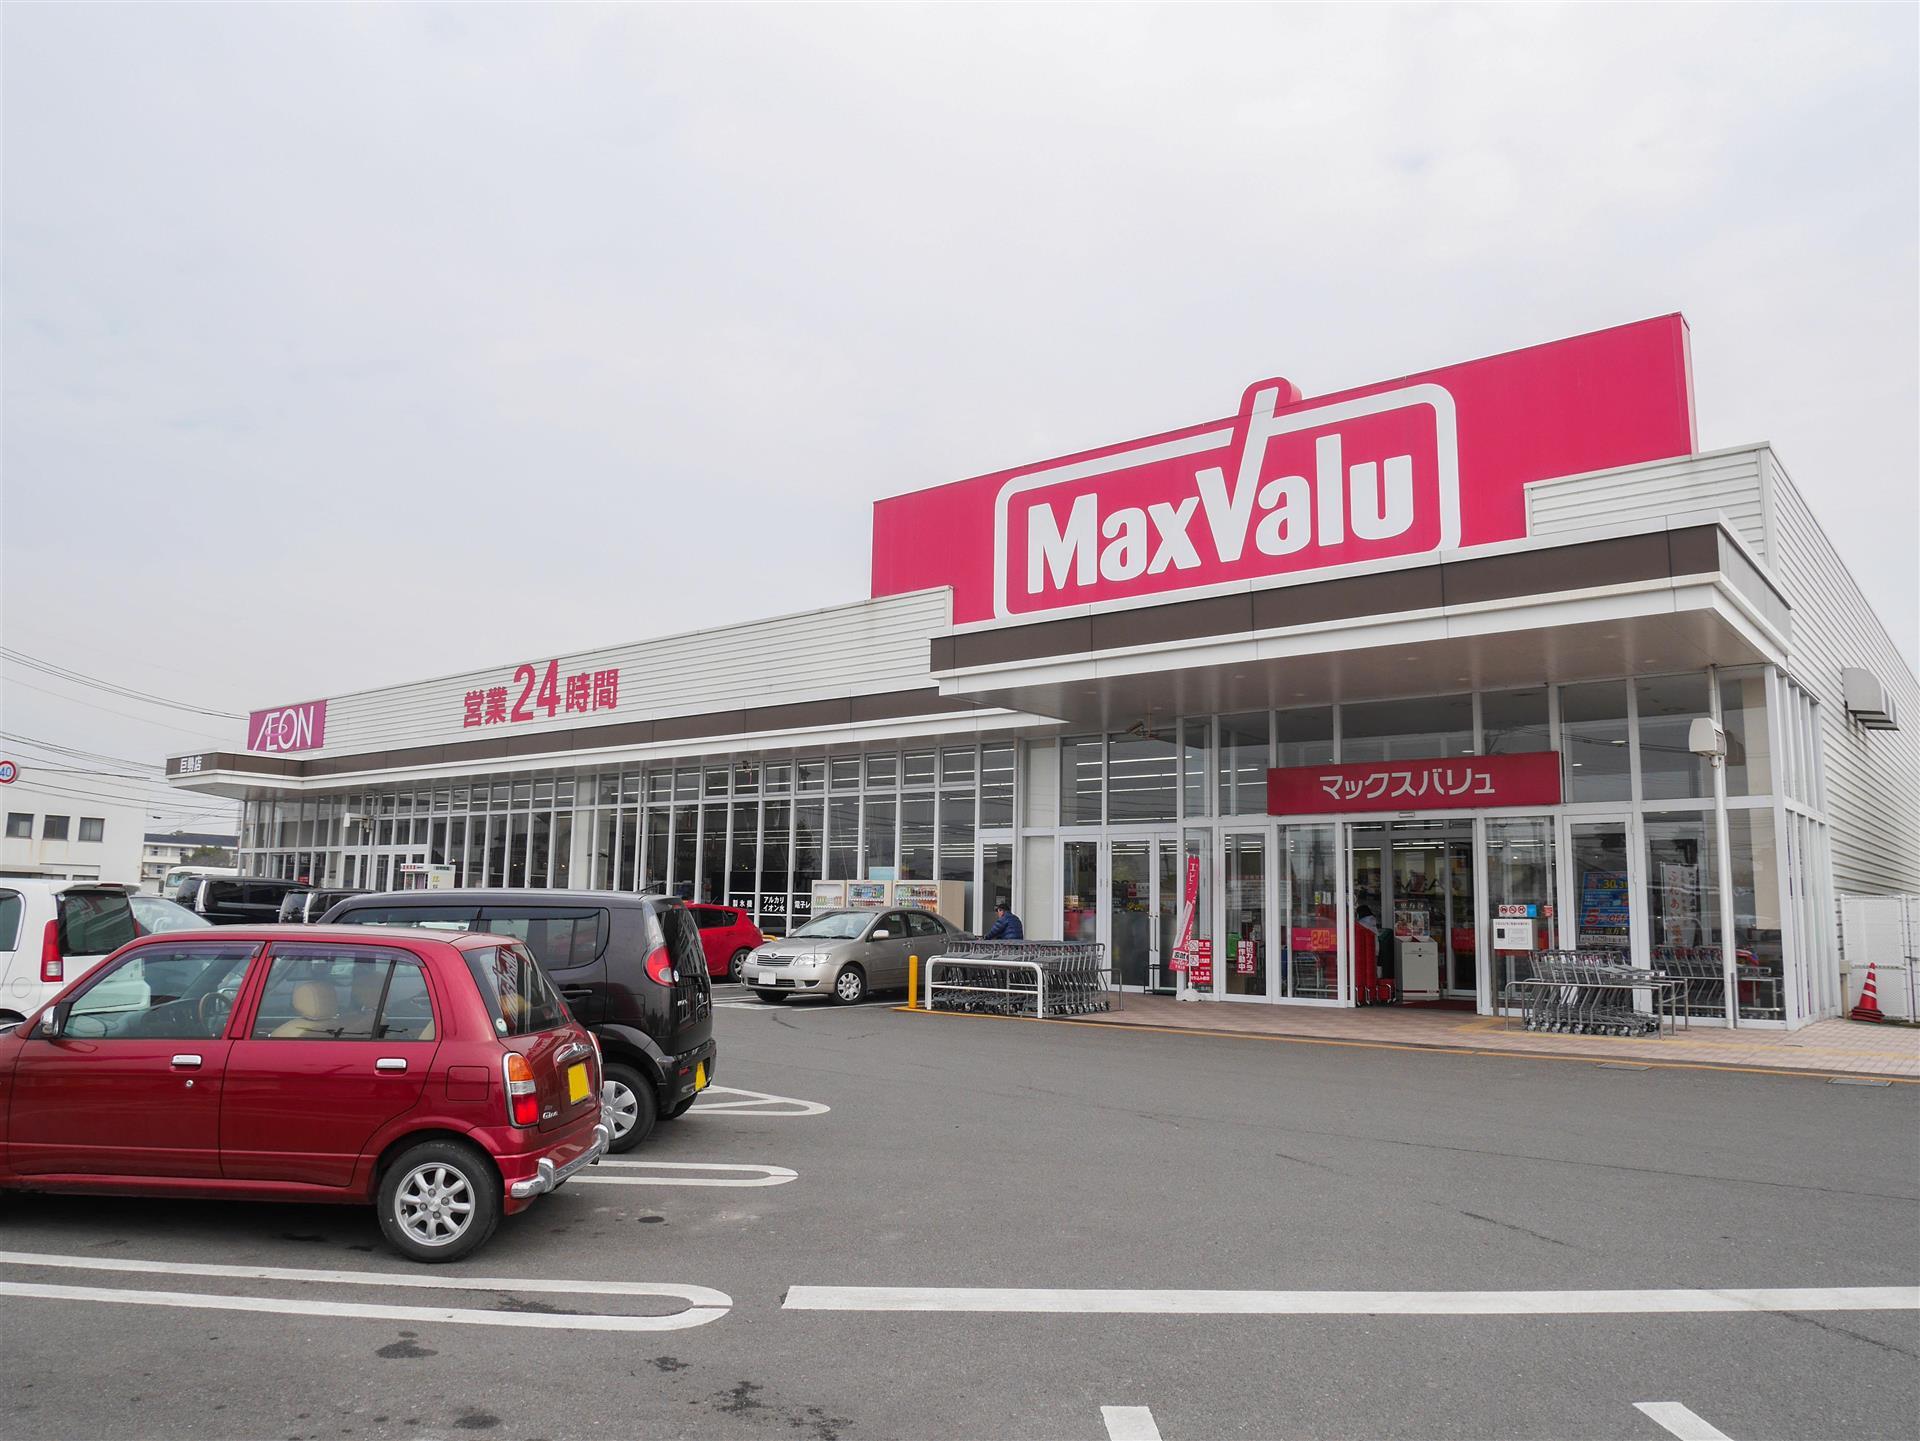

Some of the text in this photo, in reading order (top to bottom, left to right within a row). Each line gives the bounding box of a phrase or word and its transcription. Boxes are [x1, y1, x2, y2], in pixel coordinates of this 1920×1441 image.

[1027, 387, 1414, 595] MaxValu
[463, 659, 619, 728] 営業24時間
[0, 766, 12, 778] 40
[180, 756, 203, 773] 巨勢店
[1319, 768, 1496, 801] マックスバリュ
[762, 904, 786, 912] イオン水
[763, 896, 785, 904] アルカリ
